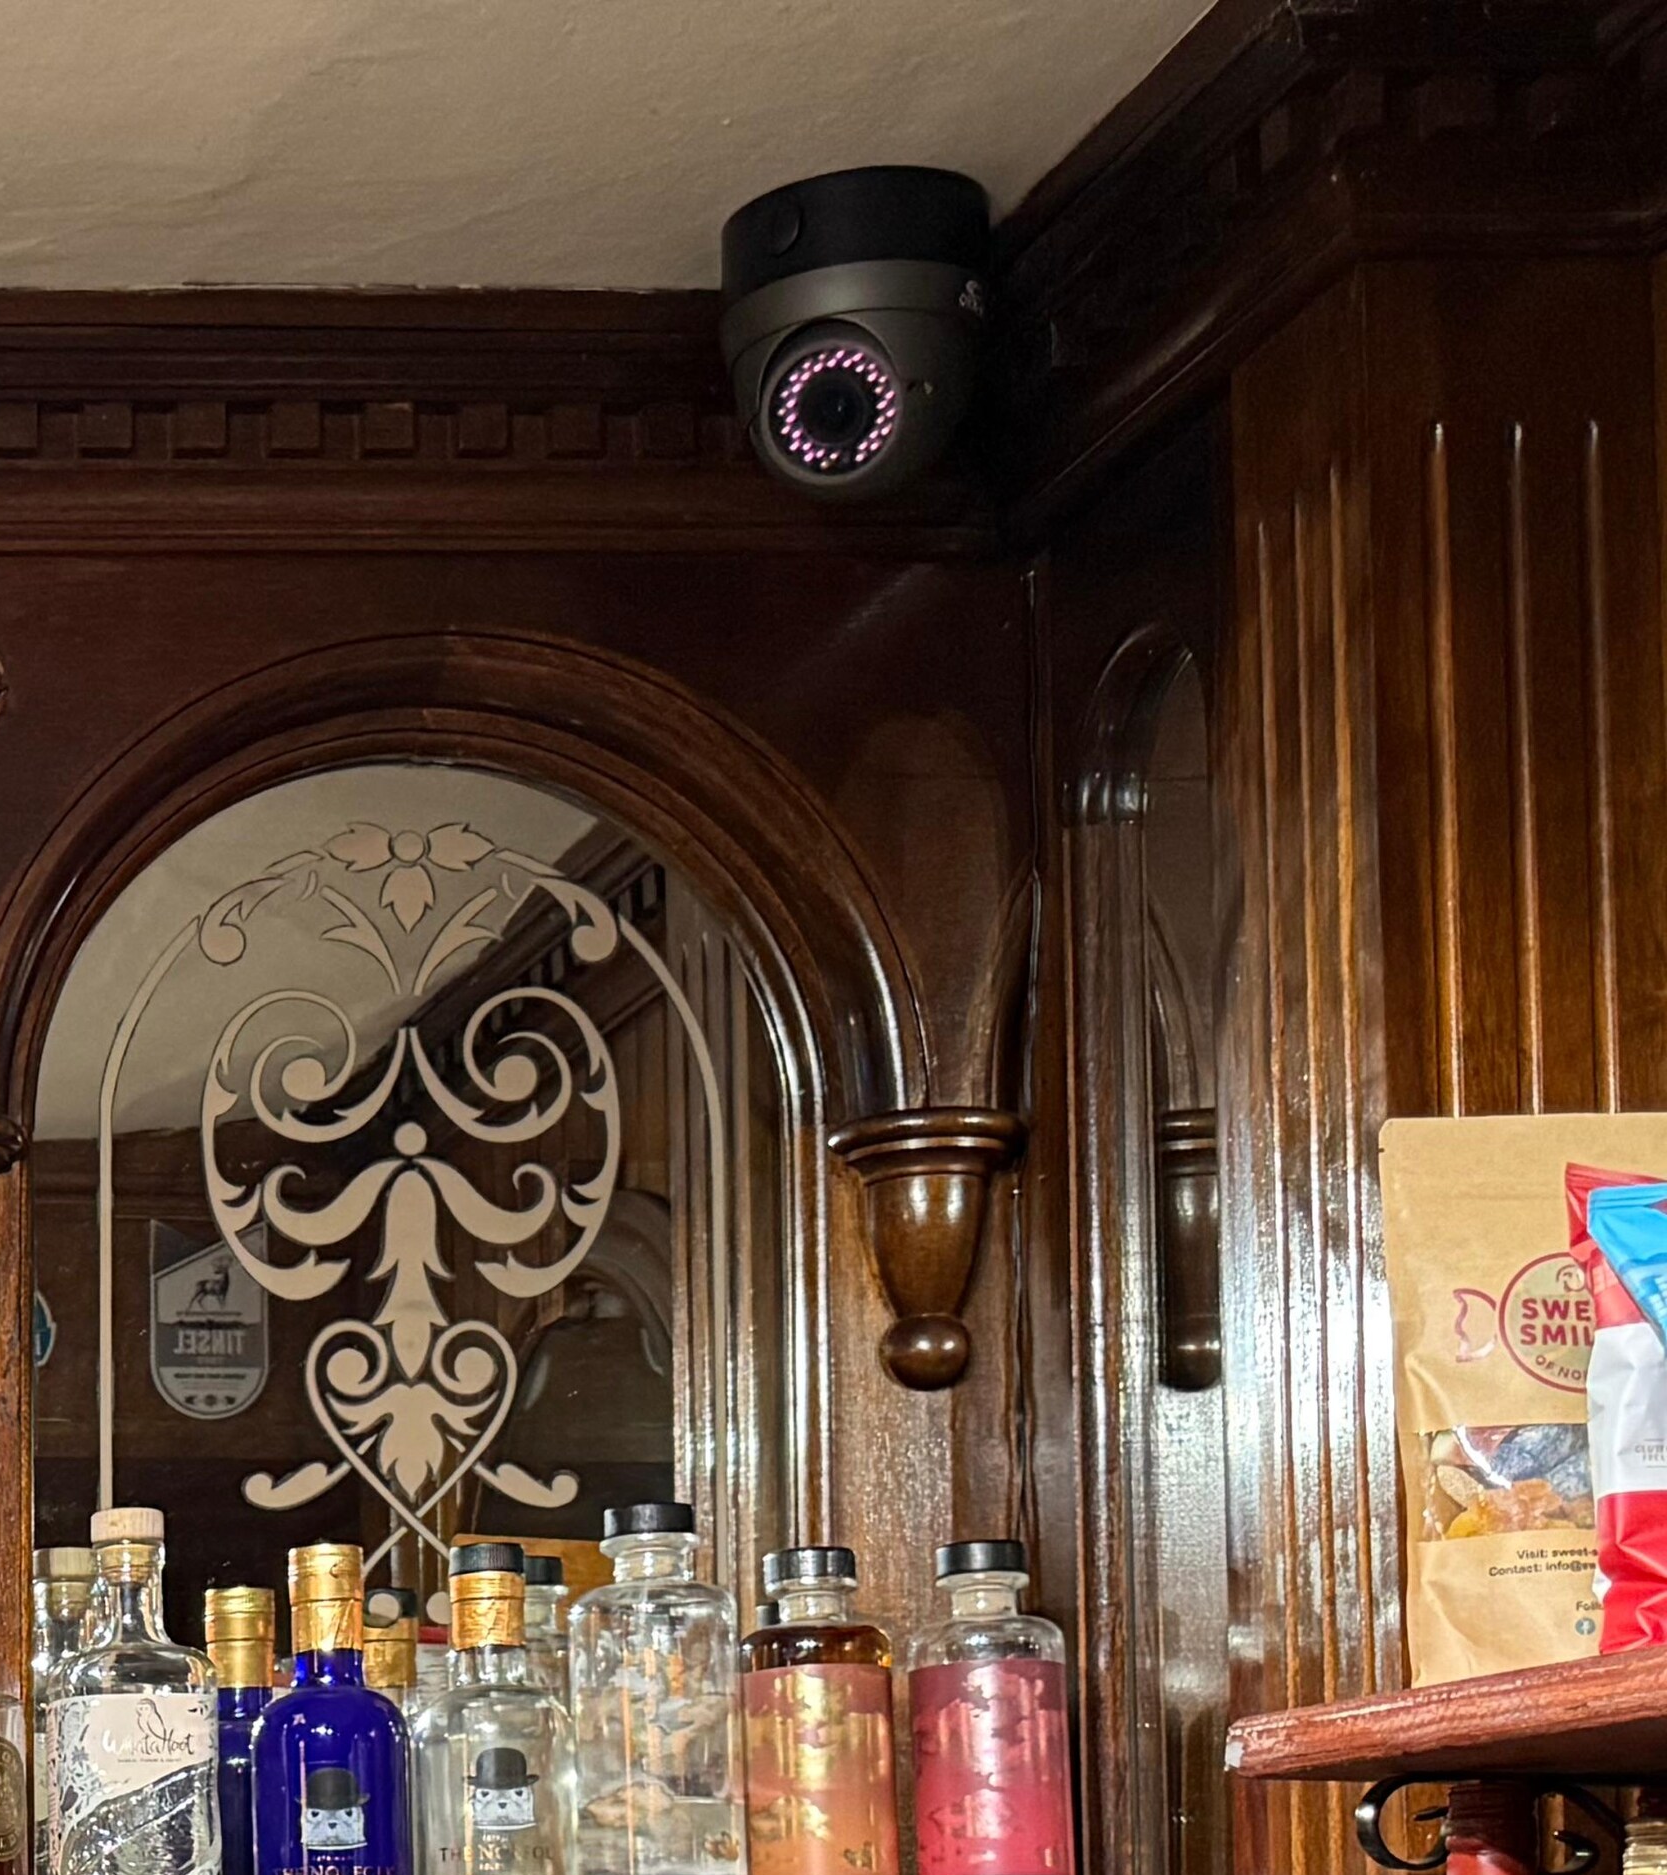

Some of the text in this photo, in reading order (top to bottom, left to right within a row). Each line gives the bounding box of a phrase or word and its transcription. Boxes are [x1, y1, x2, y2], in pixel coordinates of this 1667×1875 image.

[1536, 1354, 1554, 1370] OF
[1517, 1549, 1548, 1559] Visit:
[1489, 1564, 1542, 1576] Contact:
